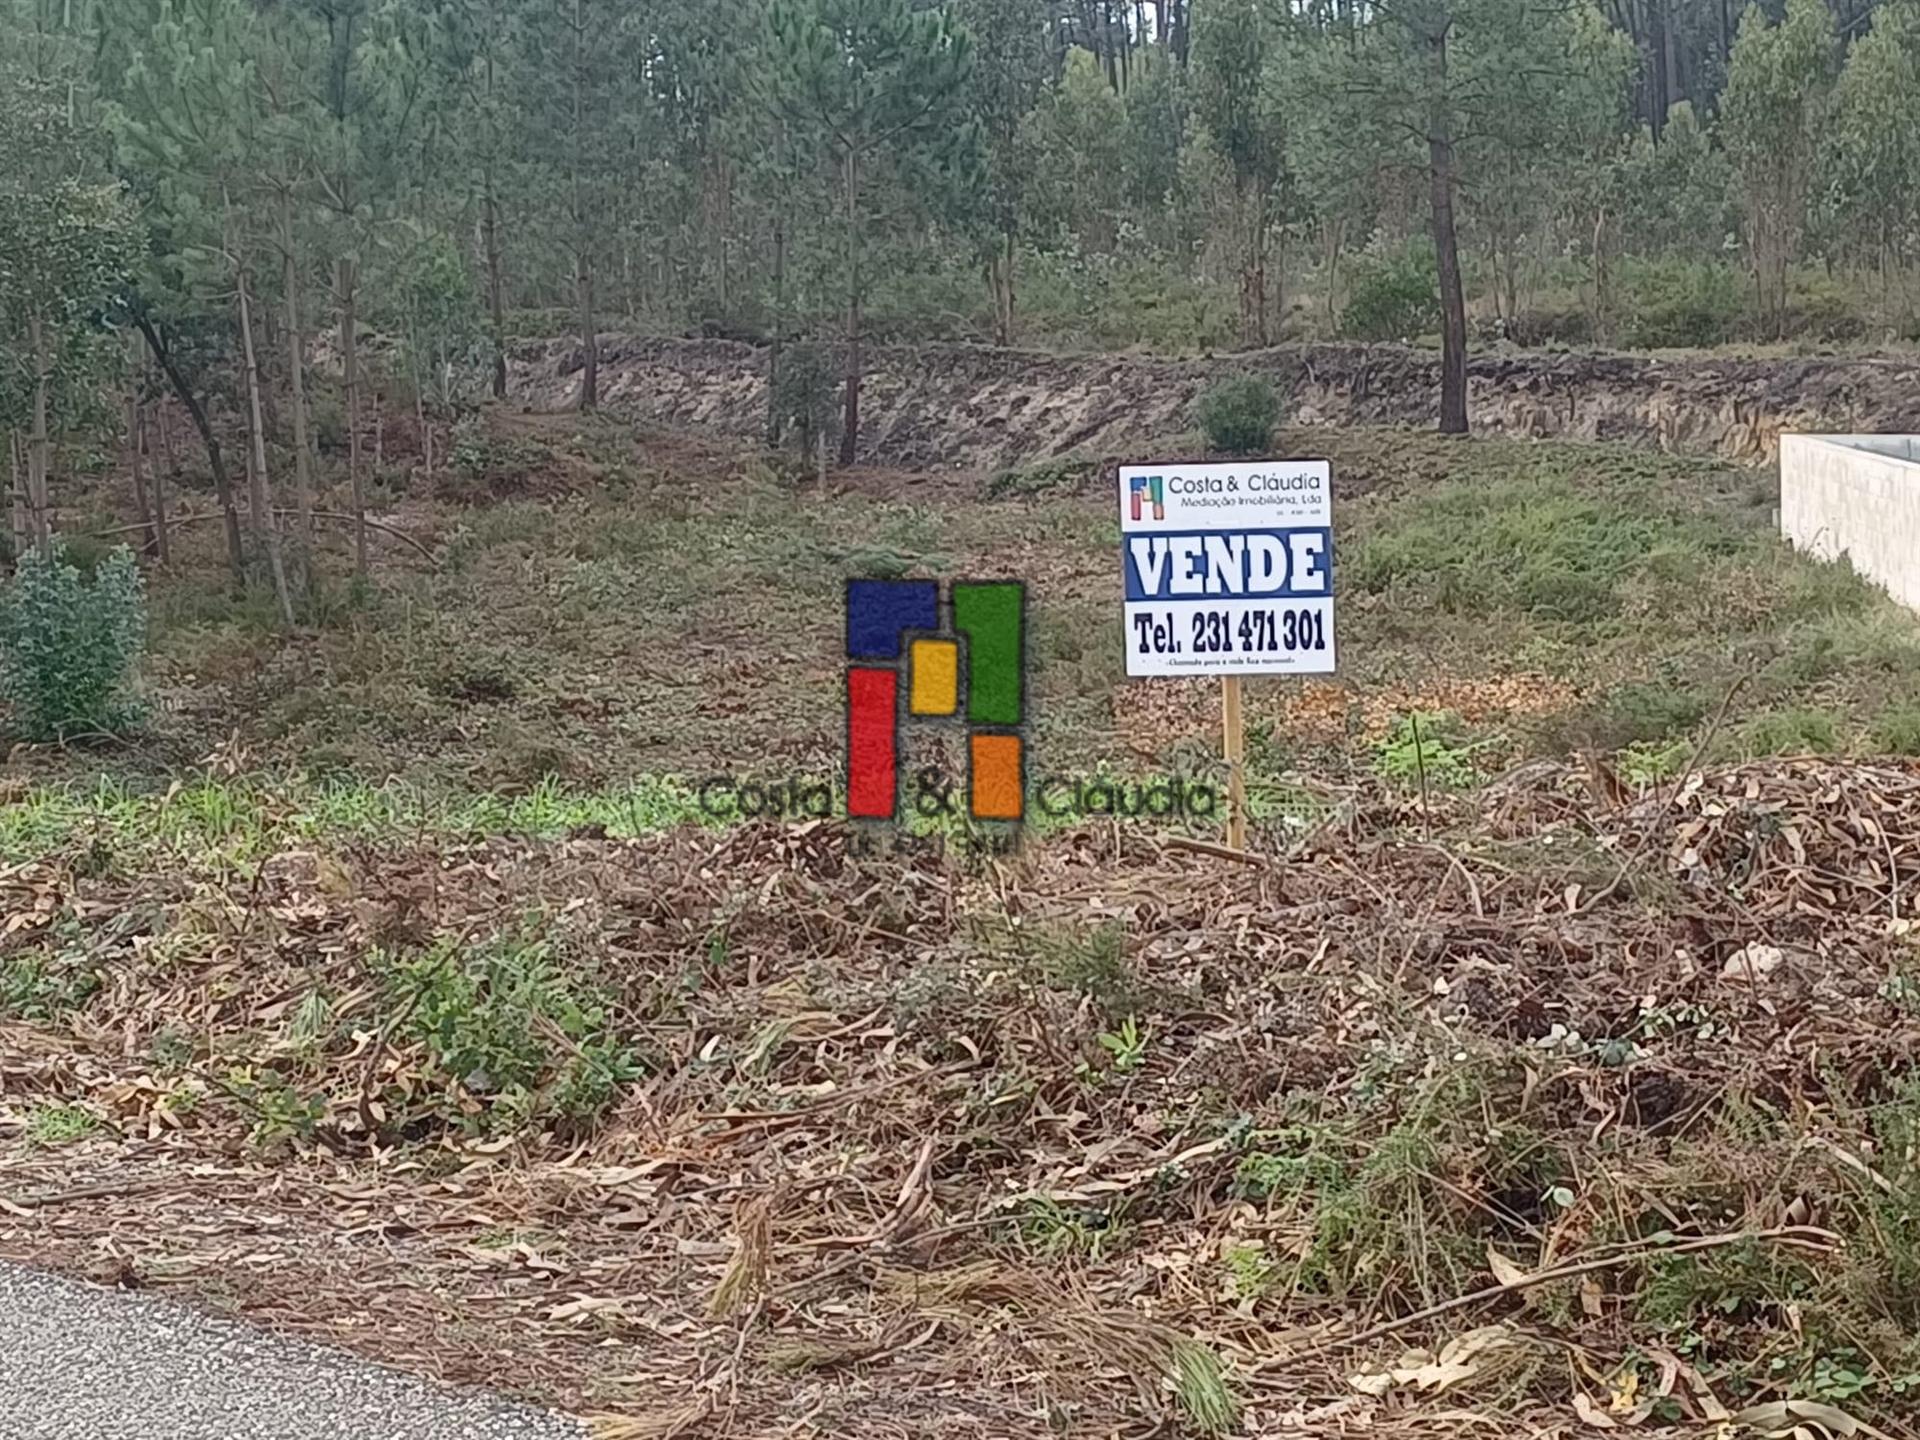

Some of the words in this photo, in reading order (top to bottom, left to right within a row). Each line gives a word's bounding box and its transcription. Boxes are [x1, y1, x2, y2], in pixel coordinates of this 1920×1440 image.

[1168, 476, 1222, 494] Costa
[1227, 475, 1240, 492] &
[1247, 472, 1321, 492] Cláudia
[1180, 496, 1236, 508] Mediação
[1129, 533, 1325, 596] VENDE
[1134, 612, 1182, 653] Tel.
[1192, 611, 1233, 652] 231
[1238, 609, 1278, 652] 471
[1283, 608, 1326, 651] 301
